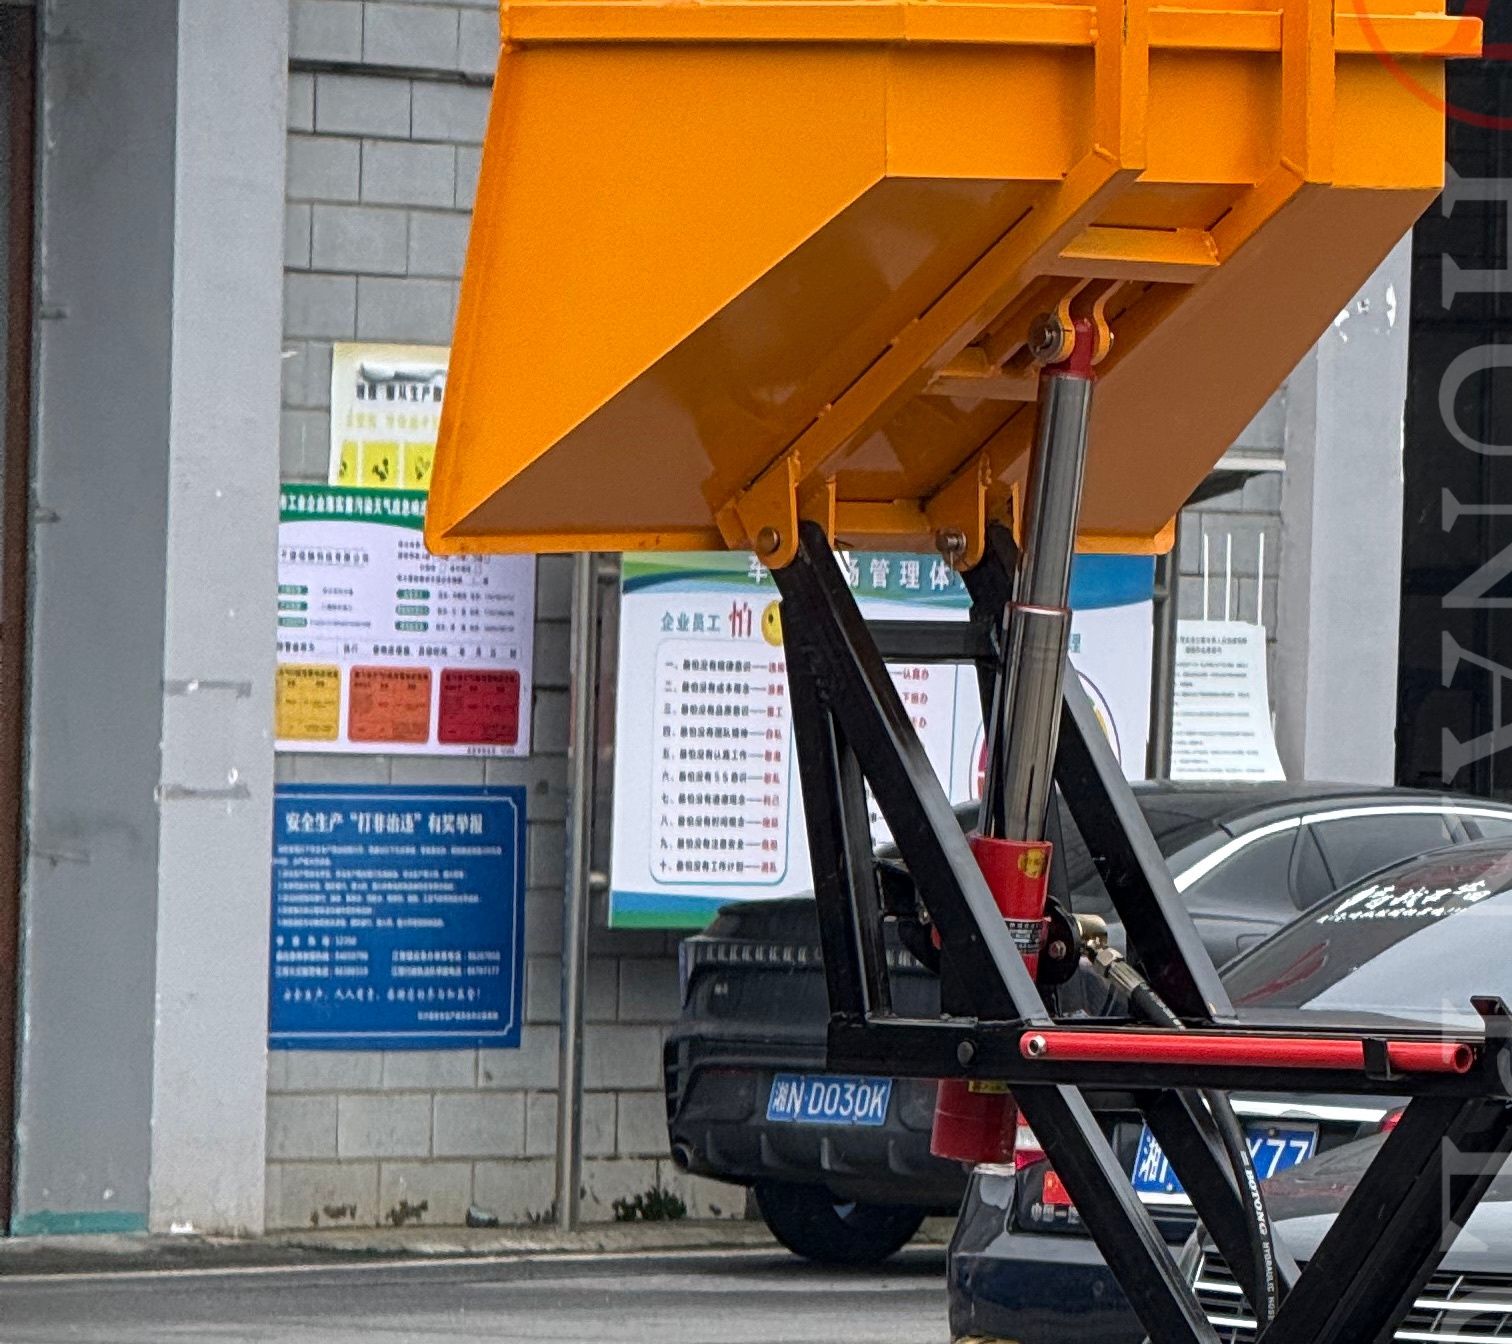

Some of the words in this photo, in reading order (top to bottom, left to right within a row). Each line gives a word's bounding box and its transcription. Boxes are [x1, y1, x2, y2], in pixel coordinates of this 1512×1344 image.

[660, 610, 721, 633] 企业员工
[1245, 1169, 1269, 1237] BOTONG
